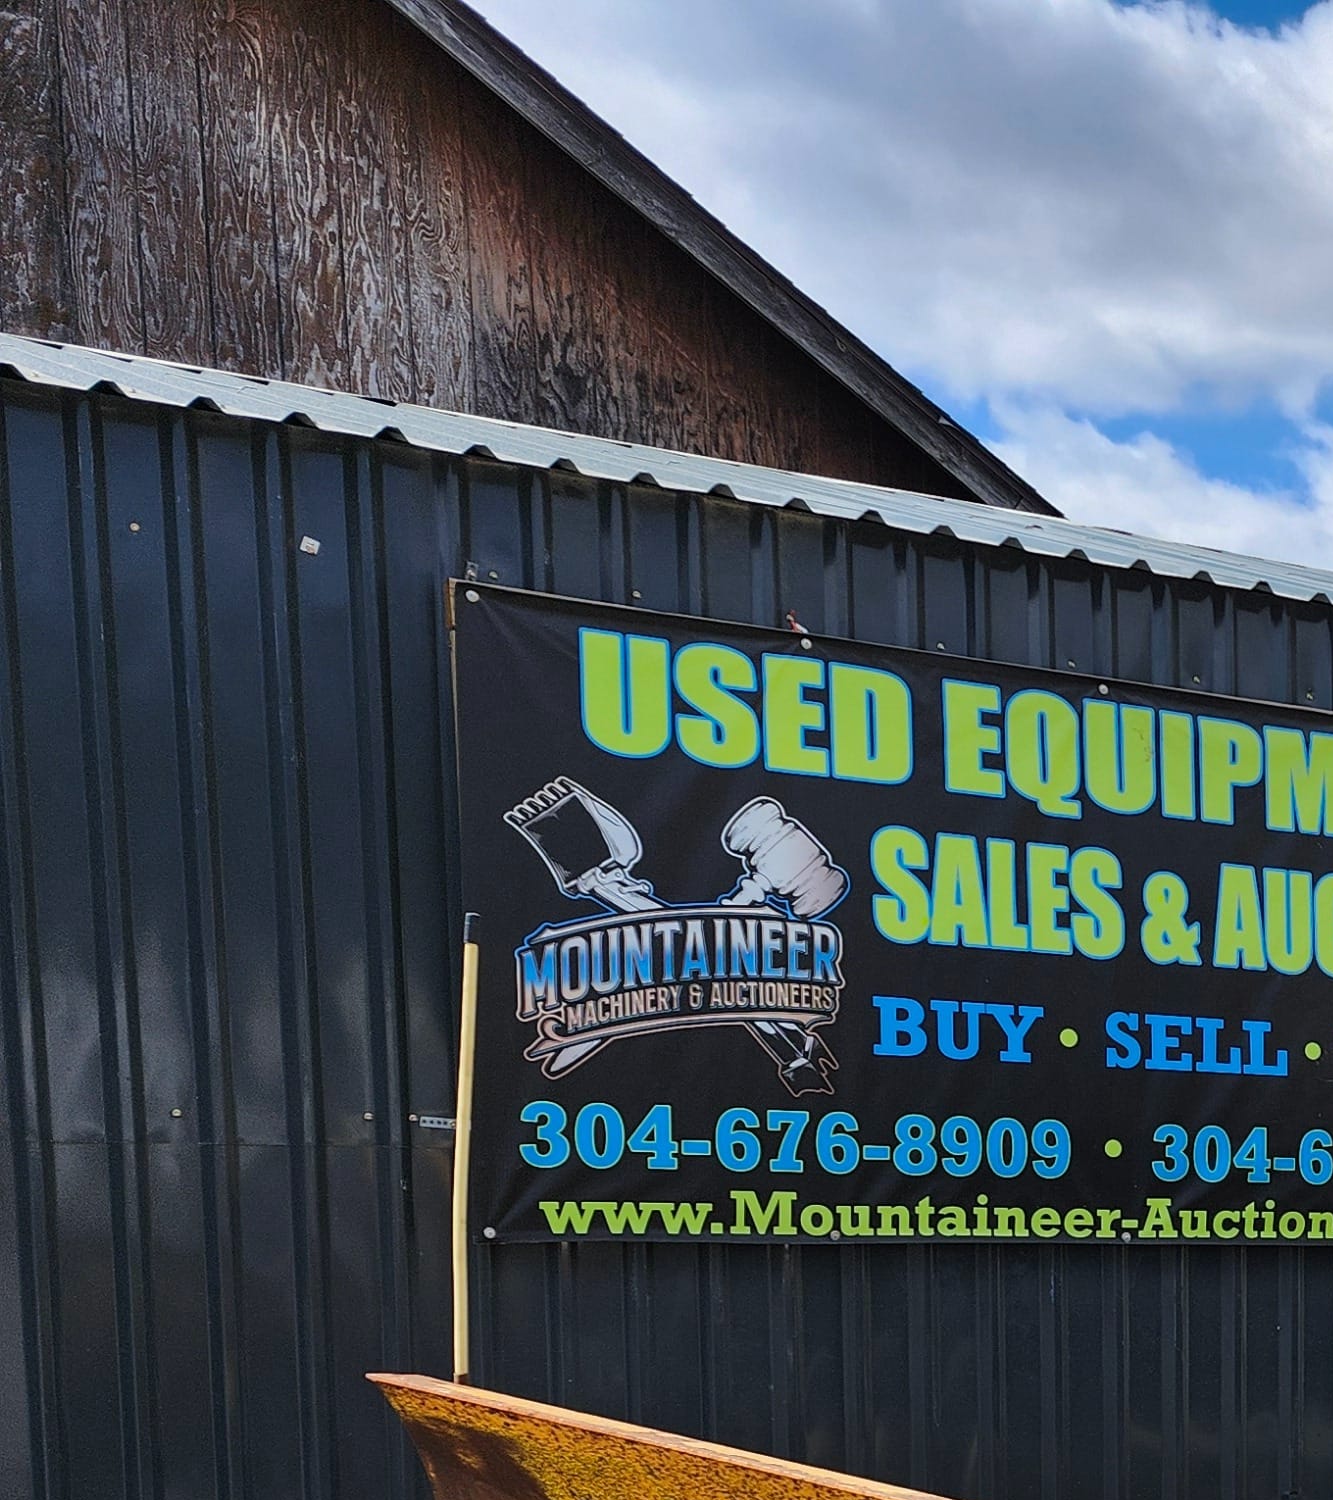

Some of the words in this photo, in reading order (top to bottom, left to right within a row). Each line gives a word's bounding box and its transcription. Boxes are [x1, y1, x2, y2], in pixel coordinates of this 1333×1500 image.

[578, 627, 912, 784] USED
[871, 826, 1124, 959] SALES
[1141, 871, 1201, 965] &
[521, 918, 838, 1016] MOUNTAINEER
[567, 984, 682, 1033] MACHINERY
[688, 985, 704, 1010] &
[709, 981, 836, 1011] AUCTIONEERS
[873, 996, 1044, 1063] BUY
[1105, 1011, 1288, 1077] SELL
[519, 1101, 1071, 1179] 304-676-8909
